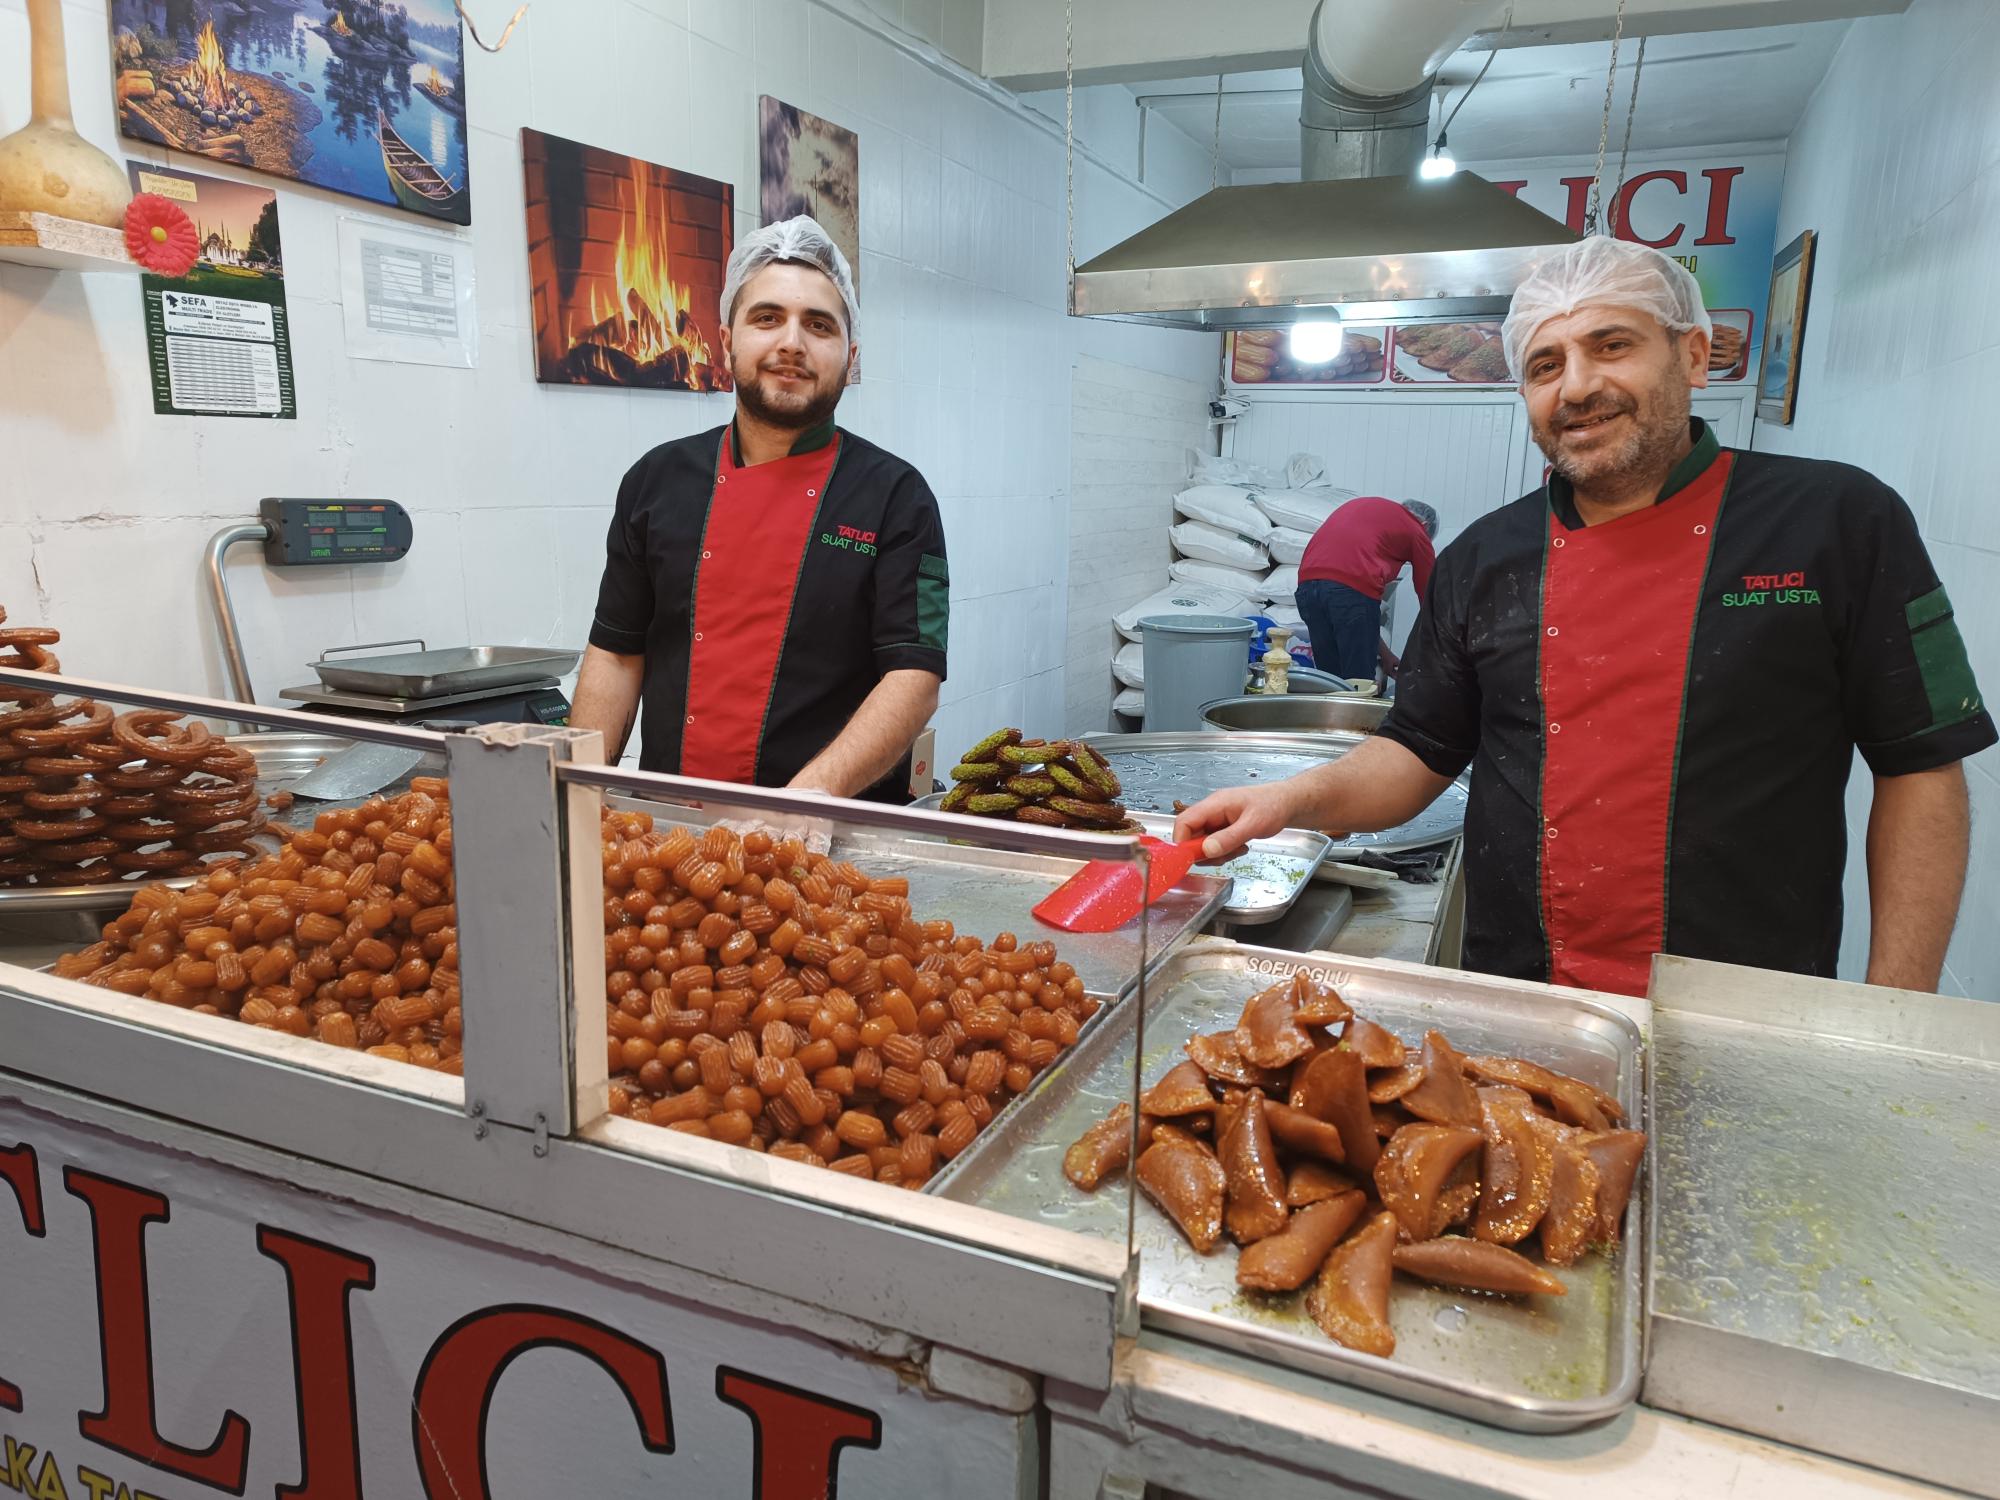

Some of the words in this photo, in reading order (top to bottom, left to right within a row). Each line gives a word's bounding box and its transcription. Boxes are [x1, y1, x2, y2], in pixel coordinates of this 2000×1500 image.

[180, 296, 207, 307] SEFA
[821, 533, 852, 550] SUAT
[837, 525, 878, 544] TATLICI
[1741, 571, 1805, 590] TATLICI
[1722, 591, 1771, 607] SUAT
[1775, 589, 1821, 605] USTA
